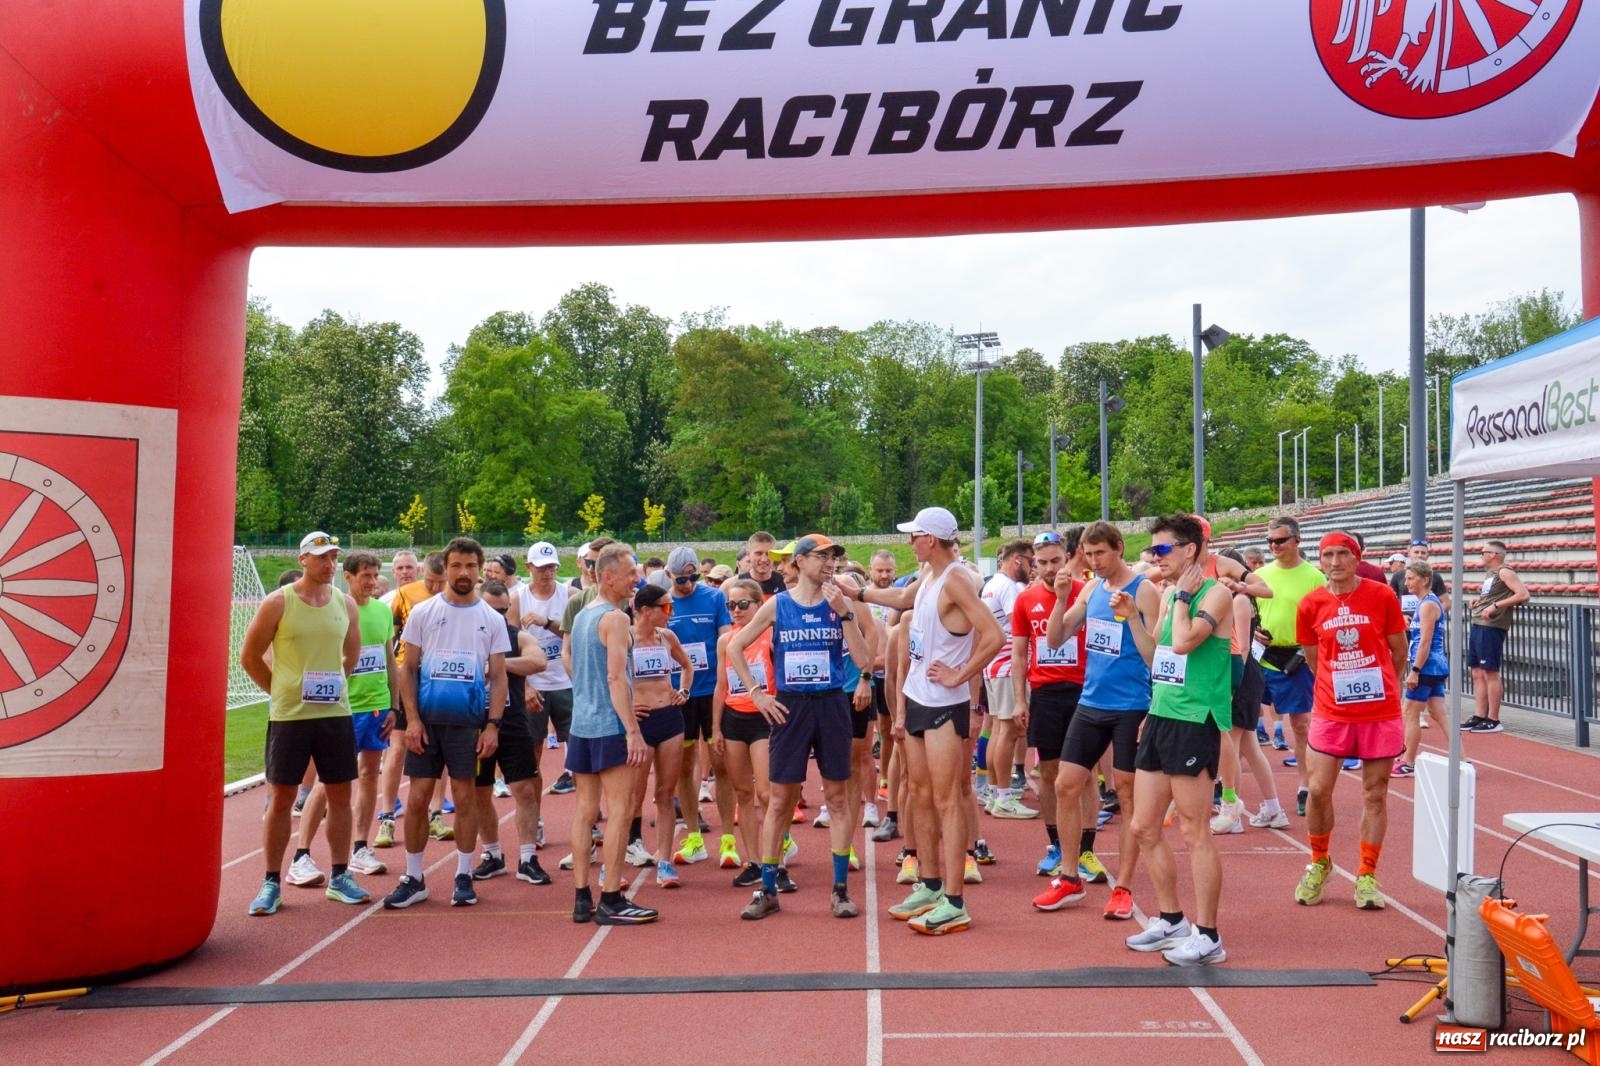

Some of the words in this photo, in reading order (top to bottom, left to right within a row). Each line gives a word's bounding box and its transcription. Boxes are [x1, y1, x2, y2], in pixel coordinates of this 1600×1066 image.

[583, 0, 777, 54] BEZ
[807, 0, 1183, 48] GRANIC
[640, 68, 1144, 162] RACIBÓRZ
[779, 627, 843, 643] RUNNERS
[1094, 632, 1111, 646] 251
[360, 656, 376, 667] 177
[441, 661, 465, 673] 205
[645, 658, 662, 669] 173
[1160, 661, 1175, 674] 158
[797, 664, 818, 675] 163
[315, 684, 334, 695] 213
[1346, 681, 1371, 695] 168
